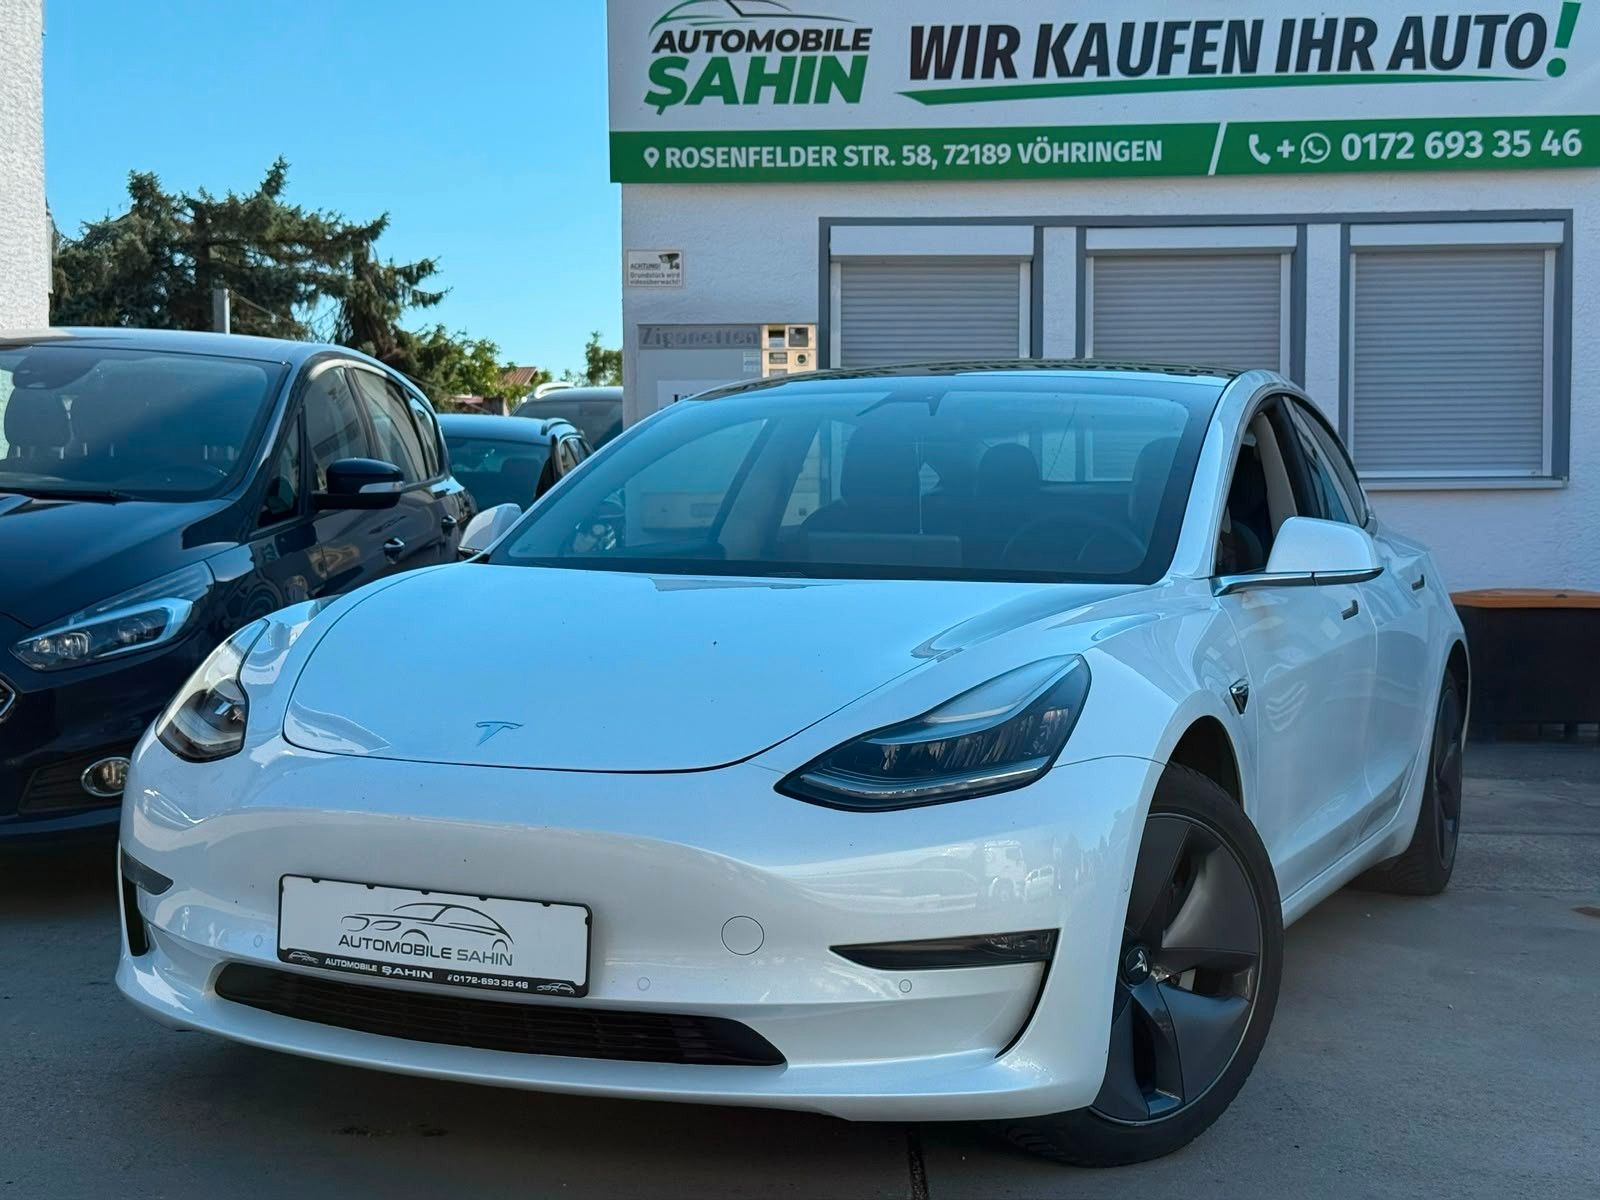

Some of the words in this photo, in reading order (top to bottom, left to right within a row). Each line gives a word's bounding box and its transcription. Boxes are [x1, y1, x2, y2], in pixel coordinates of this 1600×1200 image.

[652, 28, 873, 54] AUTOMOBILE
[909, 24, 1021, 81] WIR
[1032, 19, 1264, 79] KAUFEN
[1274, 16, 1379, 74] IHR
[1386, 2, 1582, 78] AUTO!
[643, 54, 869, 116] ŞAHIN
[665, 145, 838, 169] ROSENFELDER
[843, 144, 896, 168] STR.
[901, 143, 938, 171] 58,
[943, 142, 1010, 166] 72189
[1017, 136, 1163, 164] VÖHRINGEN
[1341, 132, 1415, 161] 0172
[1424, 130, 1484, 159] 693
[1492, 129, 1532, 158] 35
[1541, 128, 1582, 157] 46
[630, 262, 661, 270] ACHTUNG!
[324, 957, 378, 973] AUTOMOBILE
[338, 934, 452, 960] AUTOMOBILE
[456, 949, 513, 967] SAHIN
